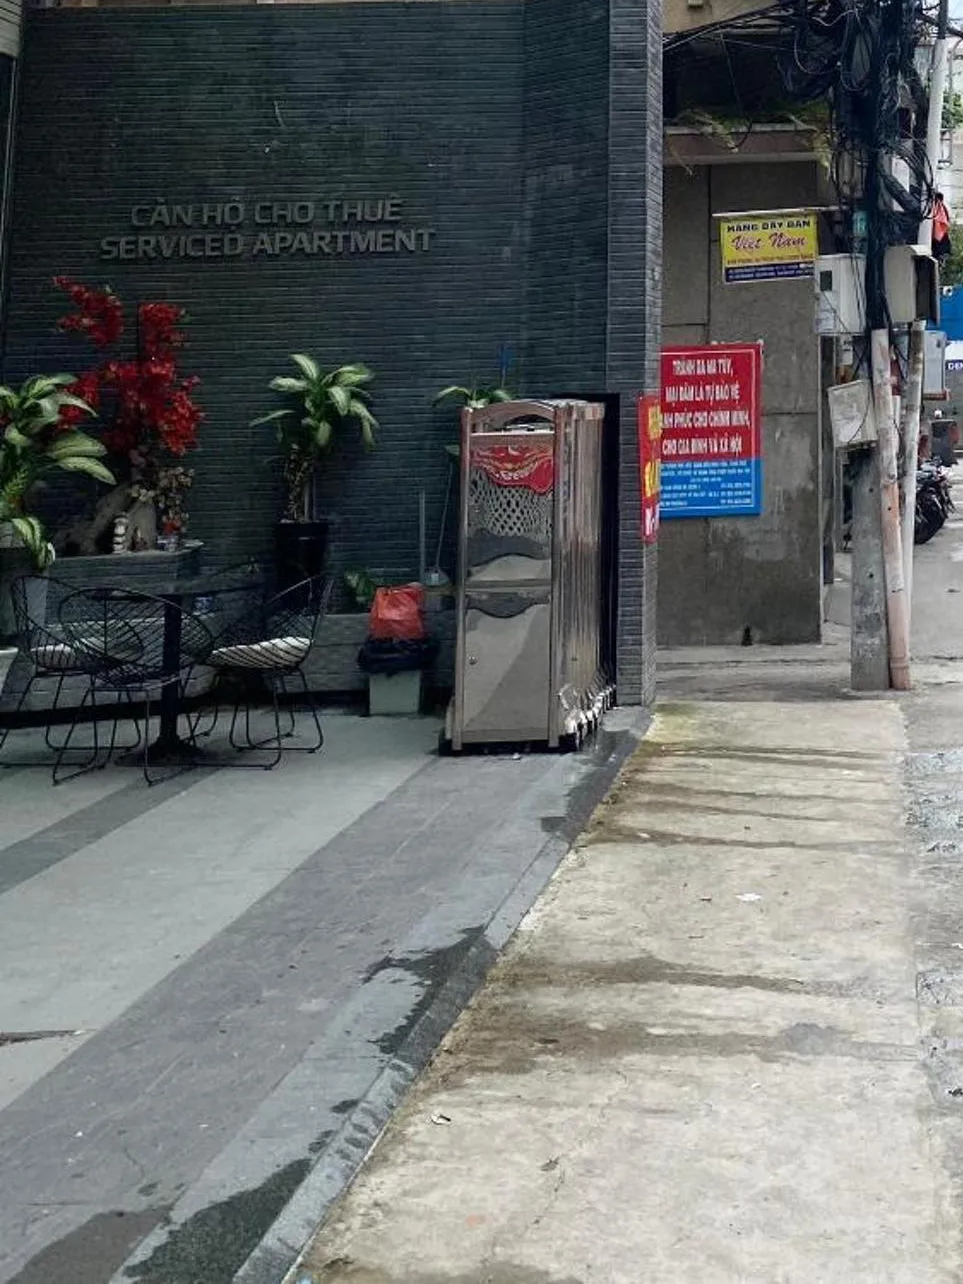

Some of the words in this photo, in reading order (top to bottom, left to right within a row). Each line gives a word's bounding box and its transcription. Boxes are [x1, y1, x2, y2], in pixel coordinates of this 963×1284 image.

[254, 202, 314, 224] CHO
[324, 193, 404, 223] THUÊ
[101, 233, 244, 260] SERVICED
[252, 228, 435, 256] APARTMENT
